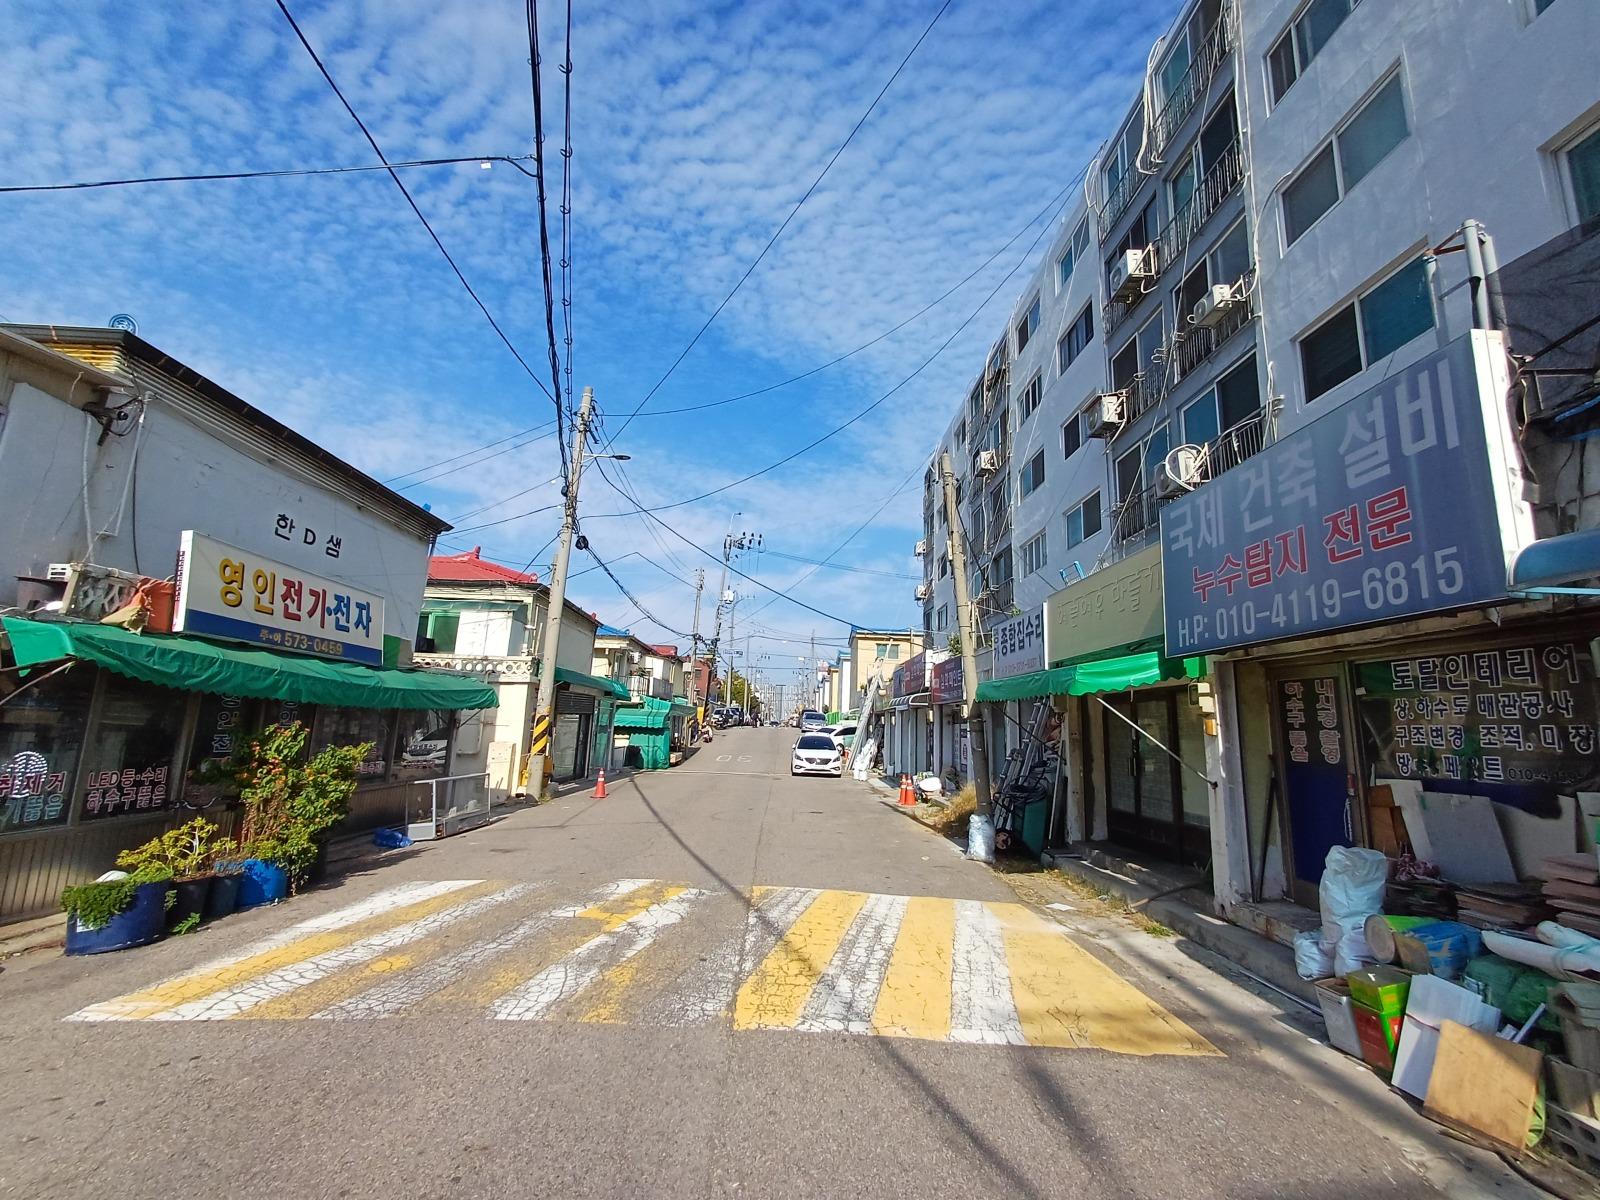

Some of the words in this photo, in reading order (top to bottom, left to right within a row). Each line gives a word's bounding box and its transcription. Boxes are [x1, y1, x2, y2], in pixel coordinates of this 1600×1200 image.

[1169, 484, 1225, 558] 국제
[1238, 446, 1318, 534] 건축
[1338, 359, 1460, 488] 설비
[1192, 524, 1308, 603] 누수탐지
[1322, 486, 1412, 564] 전문
[1216, 546, 1464, 640] 010-4119-6815
[284, 630, 343, 656] 573-0459
[1391, 643, 1580, 692] 토탈인테리어
[1314, 678, 1338, 728] 내시경
[1395, 724, 1465, 750] 구조변경
